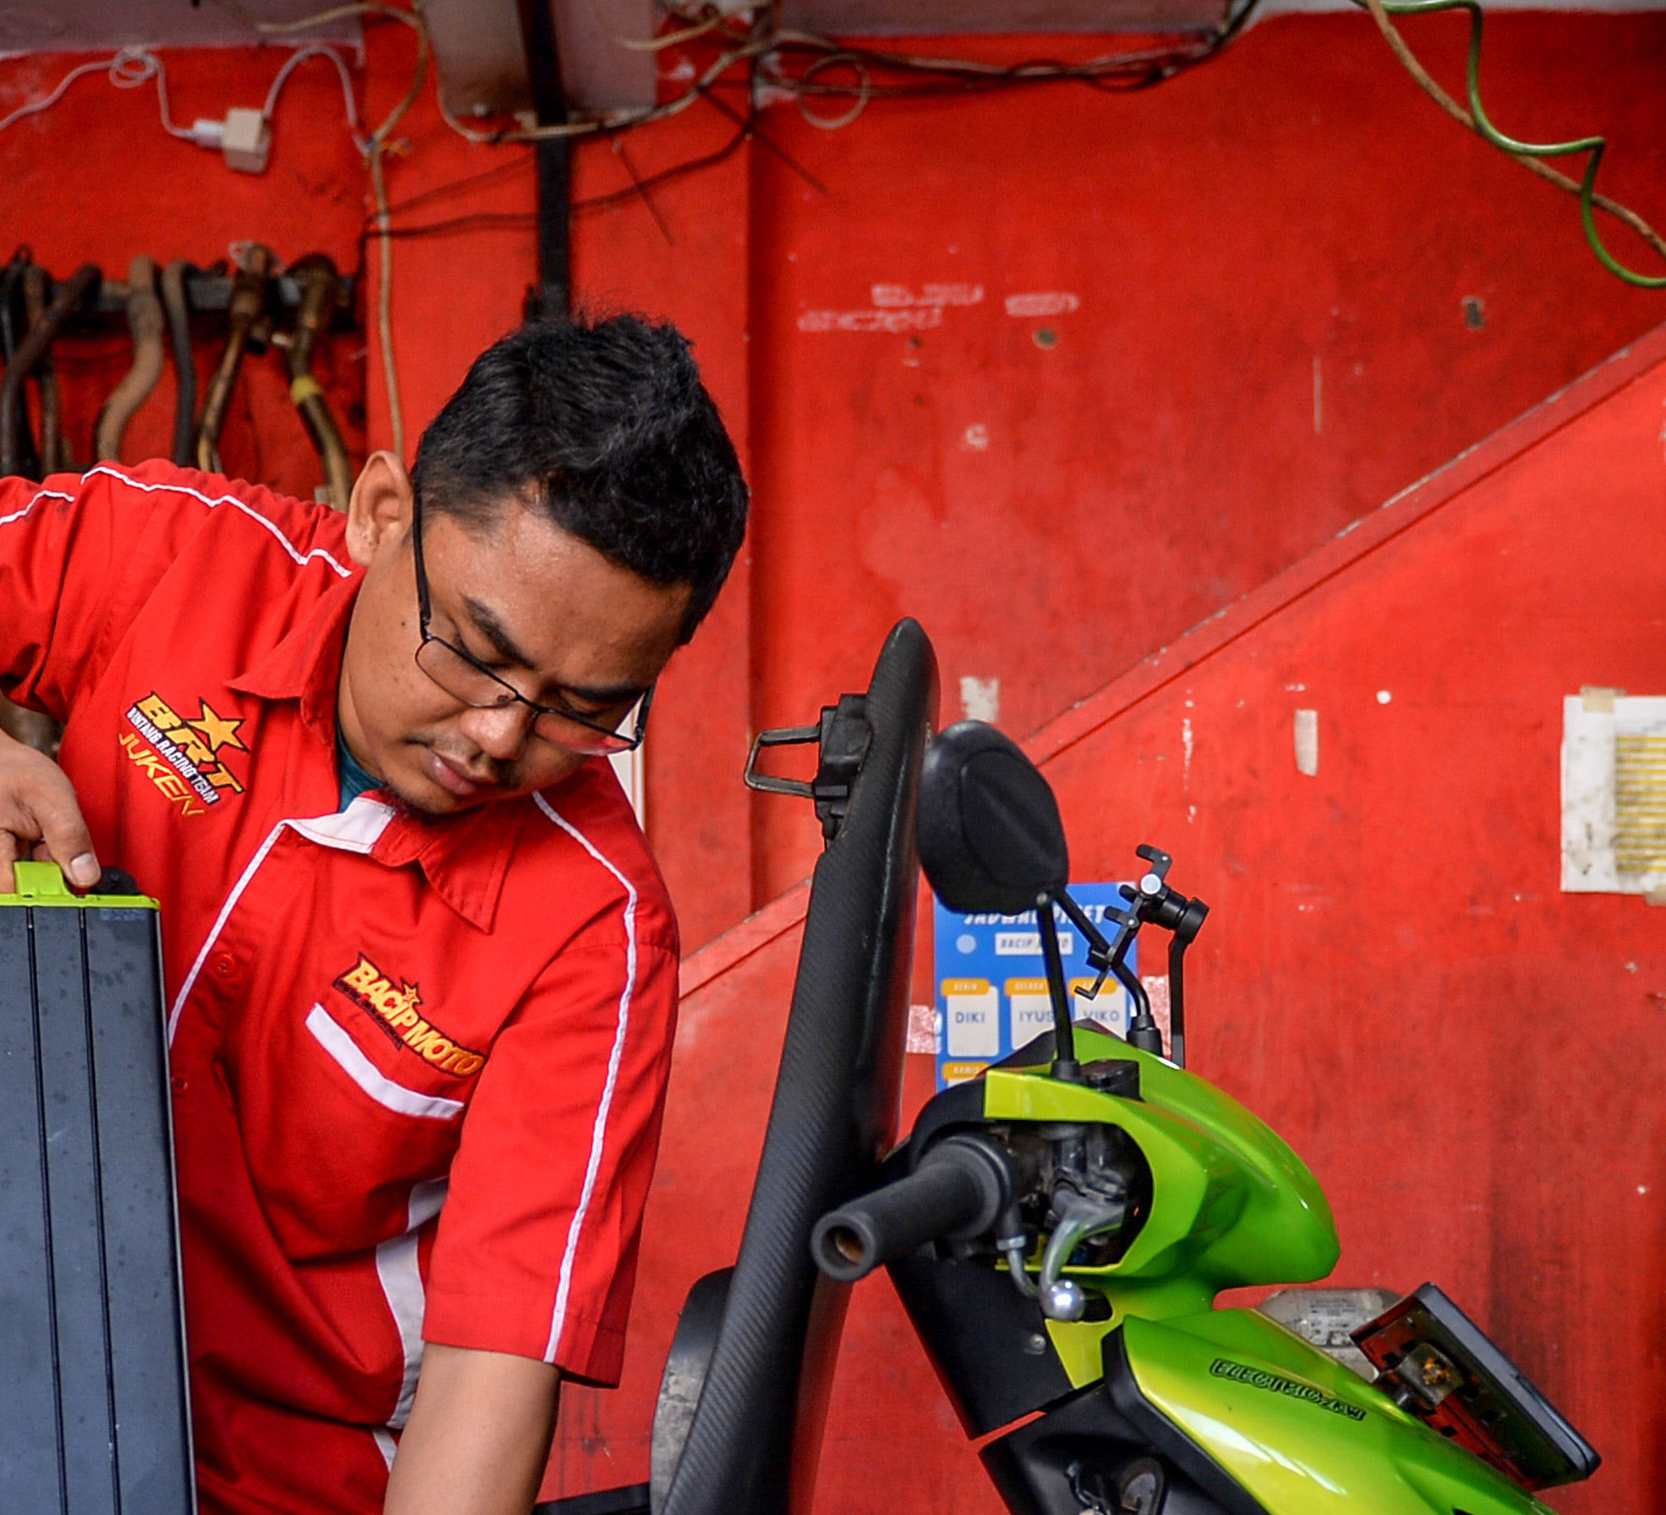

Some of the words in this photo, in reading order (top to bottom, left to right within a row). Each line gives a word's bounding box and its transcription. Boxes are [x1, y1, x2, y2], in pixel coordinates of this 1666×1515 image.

[133, 690, 245, 794] BRT
[156, 738, 198, 779] RACING
[341, 958, 420, 1028] BACIP
[401, 1019, 486, 1076] MOTO
[955, 1011, 986, 1024] DIKI
